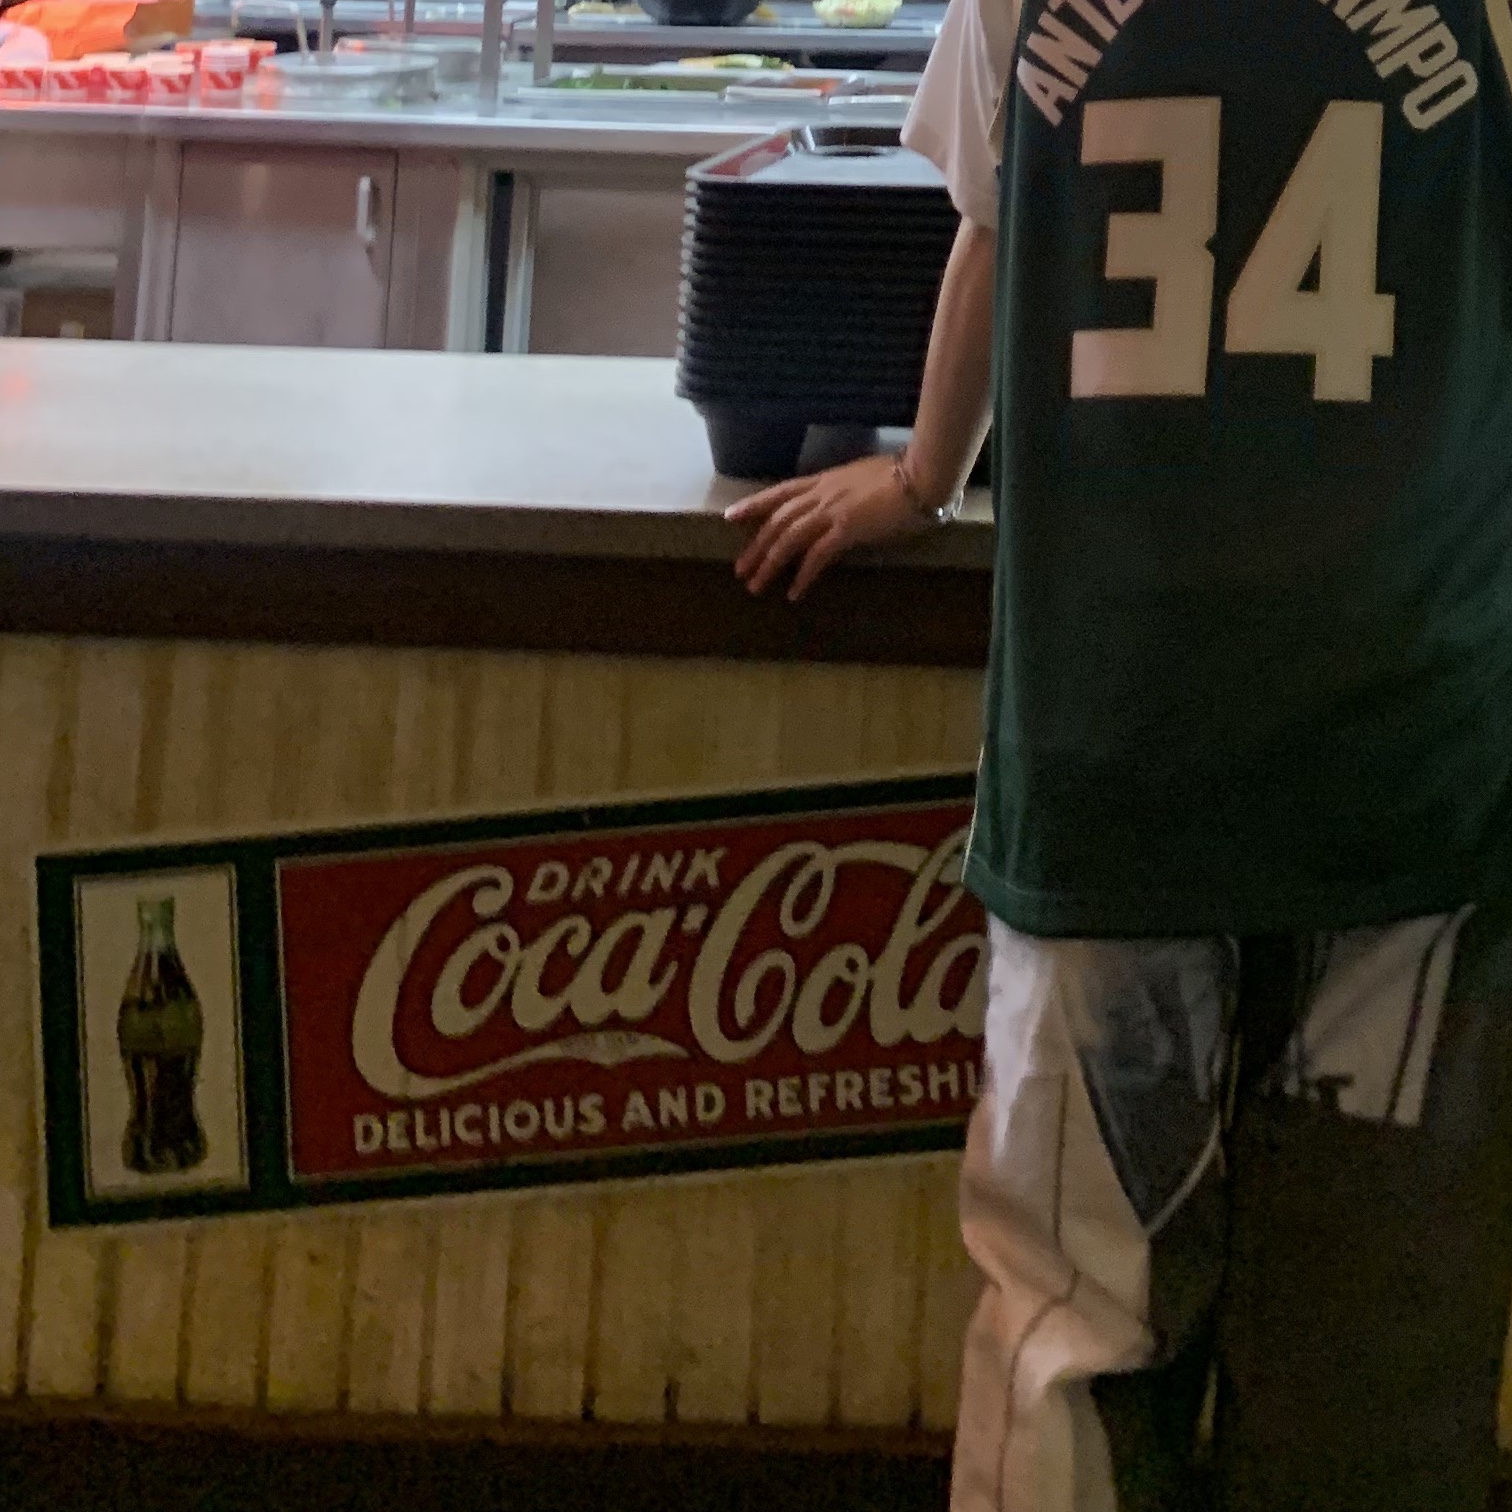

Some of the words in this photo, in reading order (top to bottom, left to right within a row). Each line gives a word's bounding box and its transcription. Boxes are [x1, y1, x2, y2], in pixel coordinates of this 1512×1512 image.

[1070, 96, 1396, 403] 34
[527, 847, 729, 905] DRINK
[353, 1089, 607, 1156] DELICIOUS
[622, 1087, 726, 1132] AND
